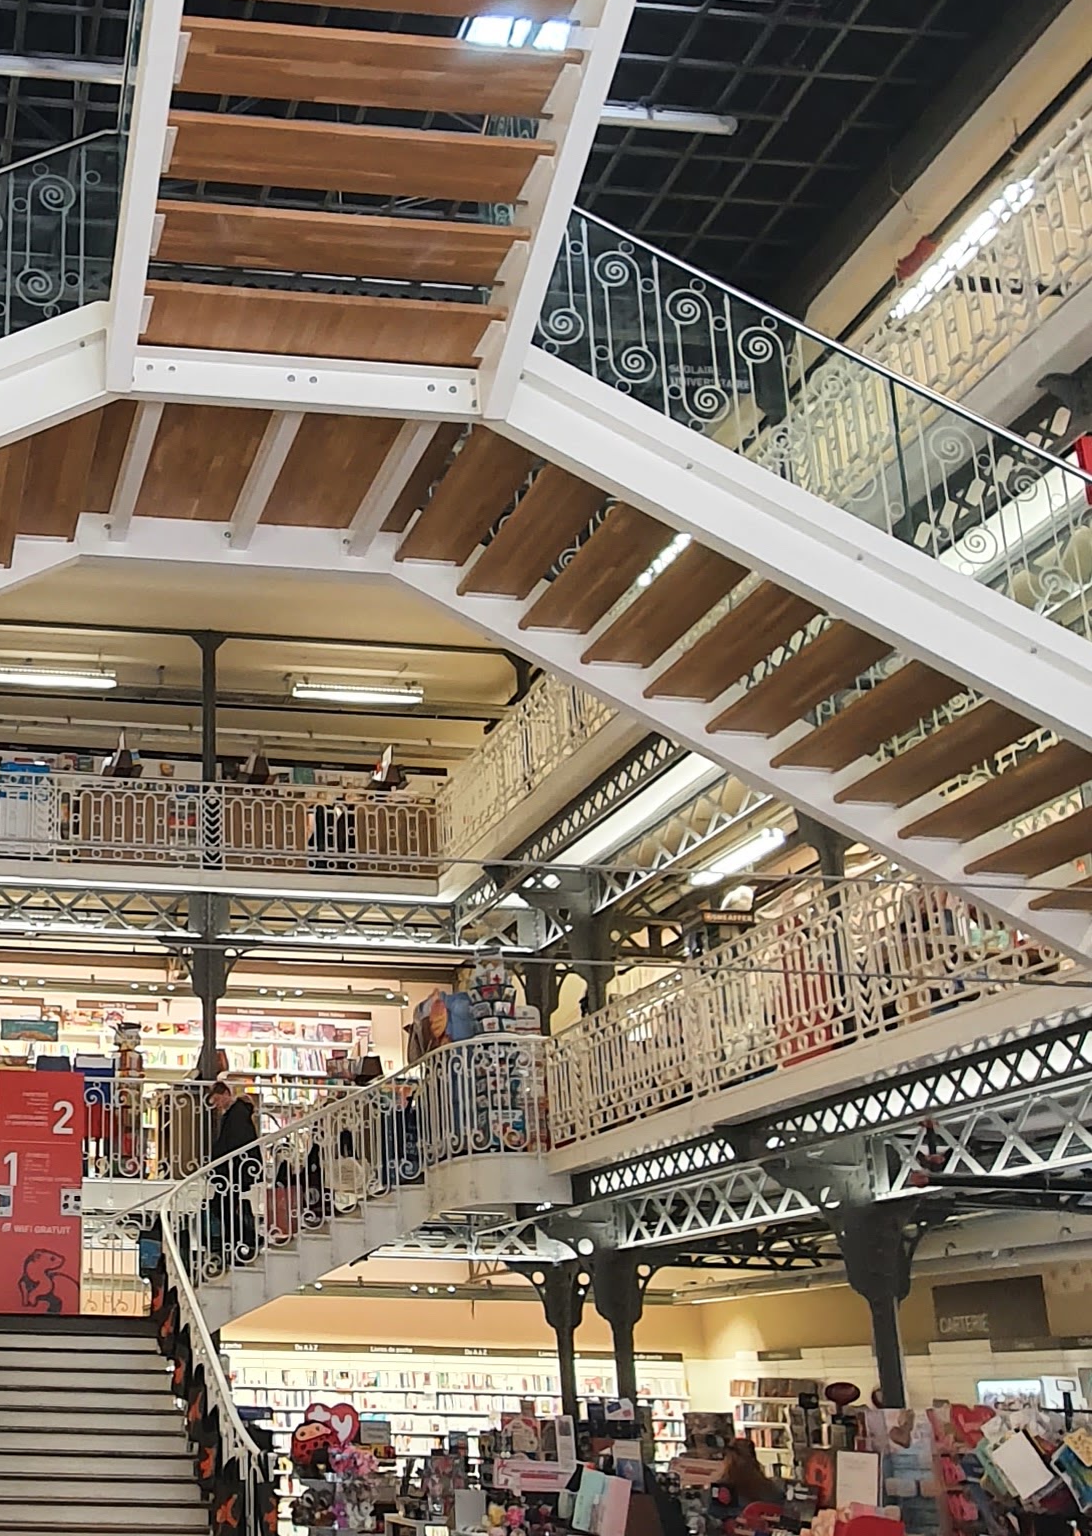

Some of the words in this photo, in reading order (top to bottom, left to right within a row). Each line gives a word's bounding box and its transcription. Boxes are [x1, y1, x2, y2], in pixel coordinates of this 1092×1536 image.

[52, 1100, 75, 1135] 2
[3, 1152, 18, 1187] 1
[34, 1225, 72, 1234] GRATUIT
